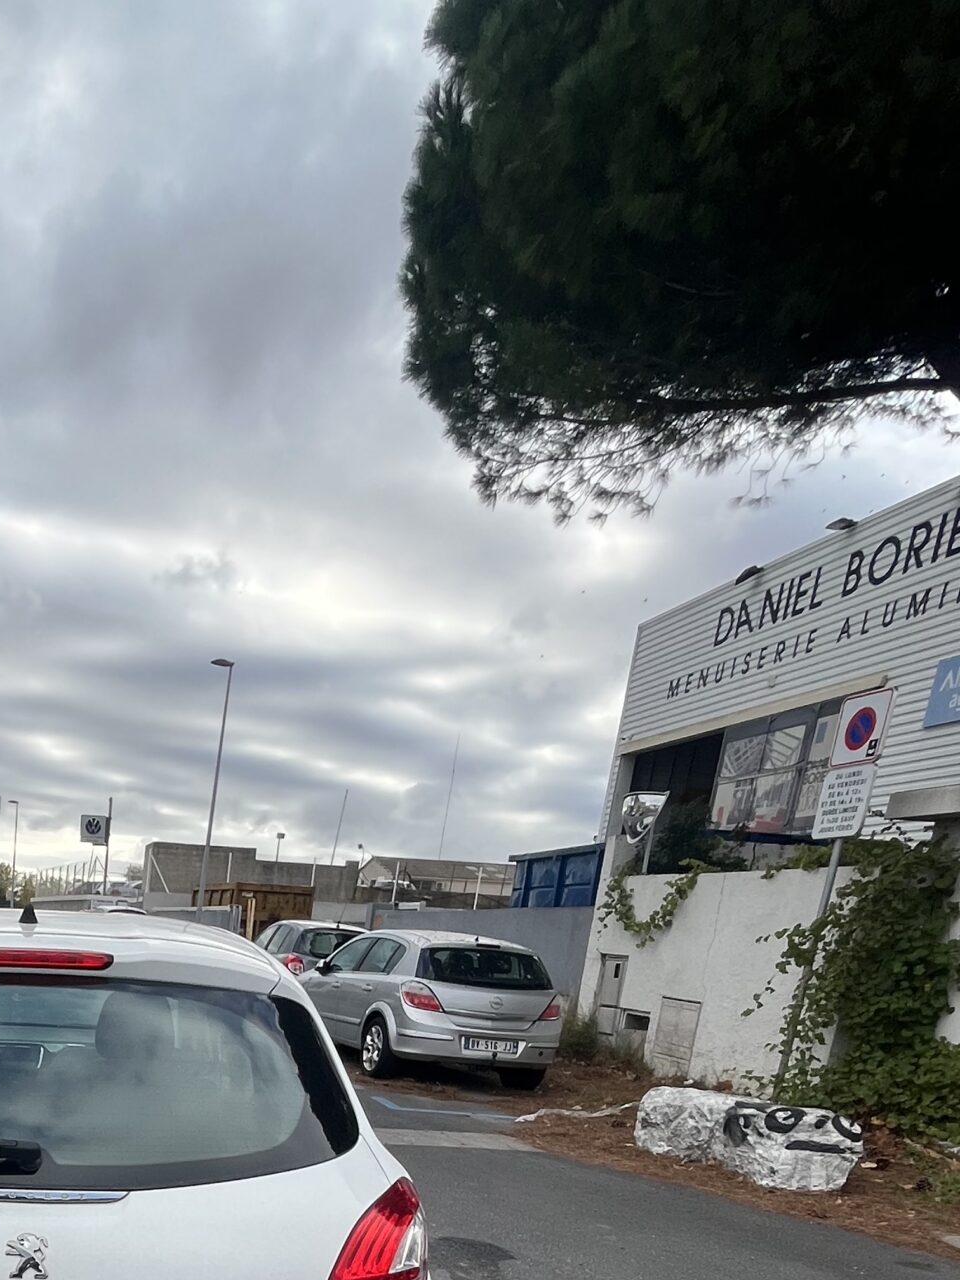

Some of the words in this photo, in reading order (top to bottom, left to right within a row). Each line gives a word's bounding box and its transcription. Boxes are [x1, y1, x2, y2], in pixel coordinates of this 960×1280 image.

[666, 629, 818, 700] MENUISERIE
[837, 578, 960, 644] ALUMI
[713, 567, 824, 648] DANIEL
